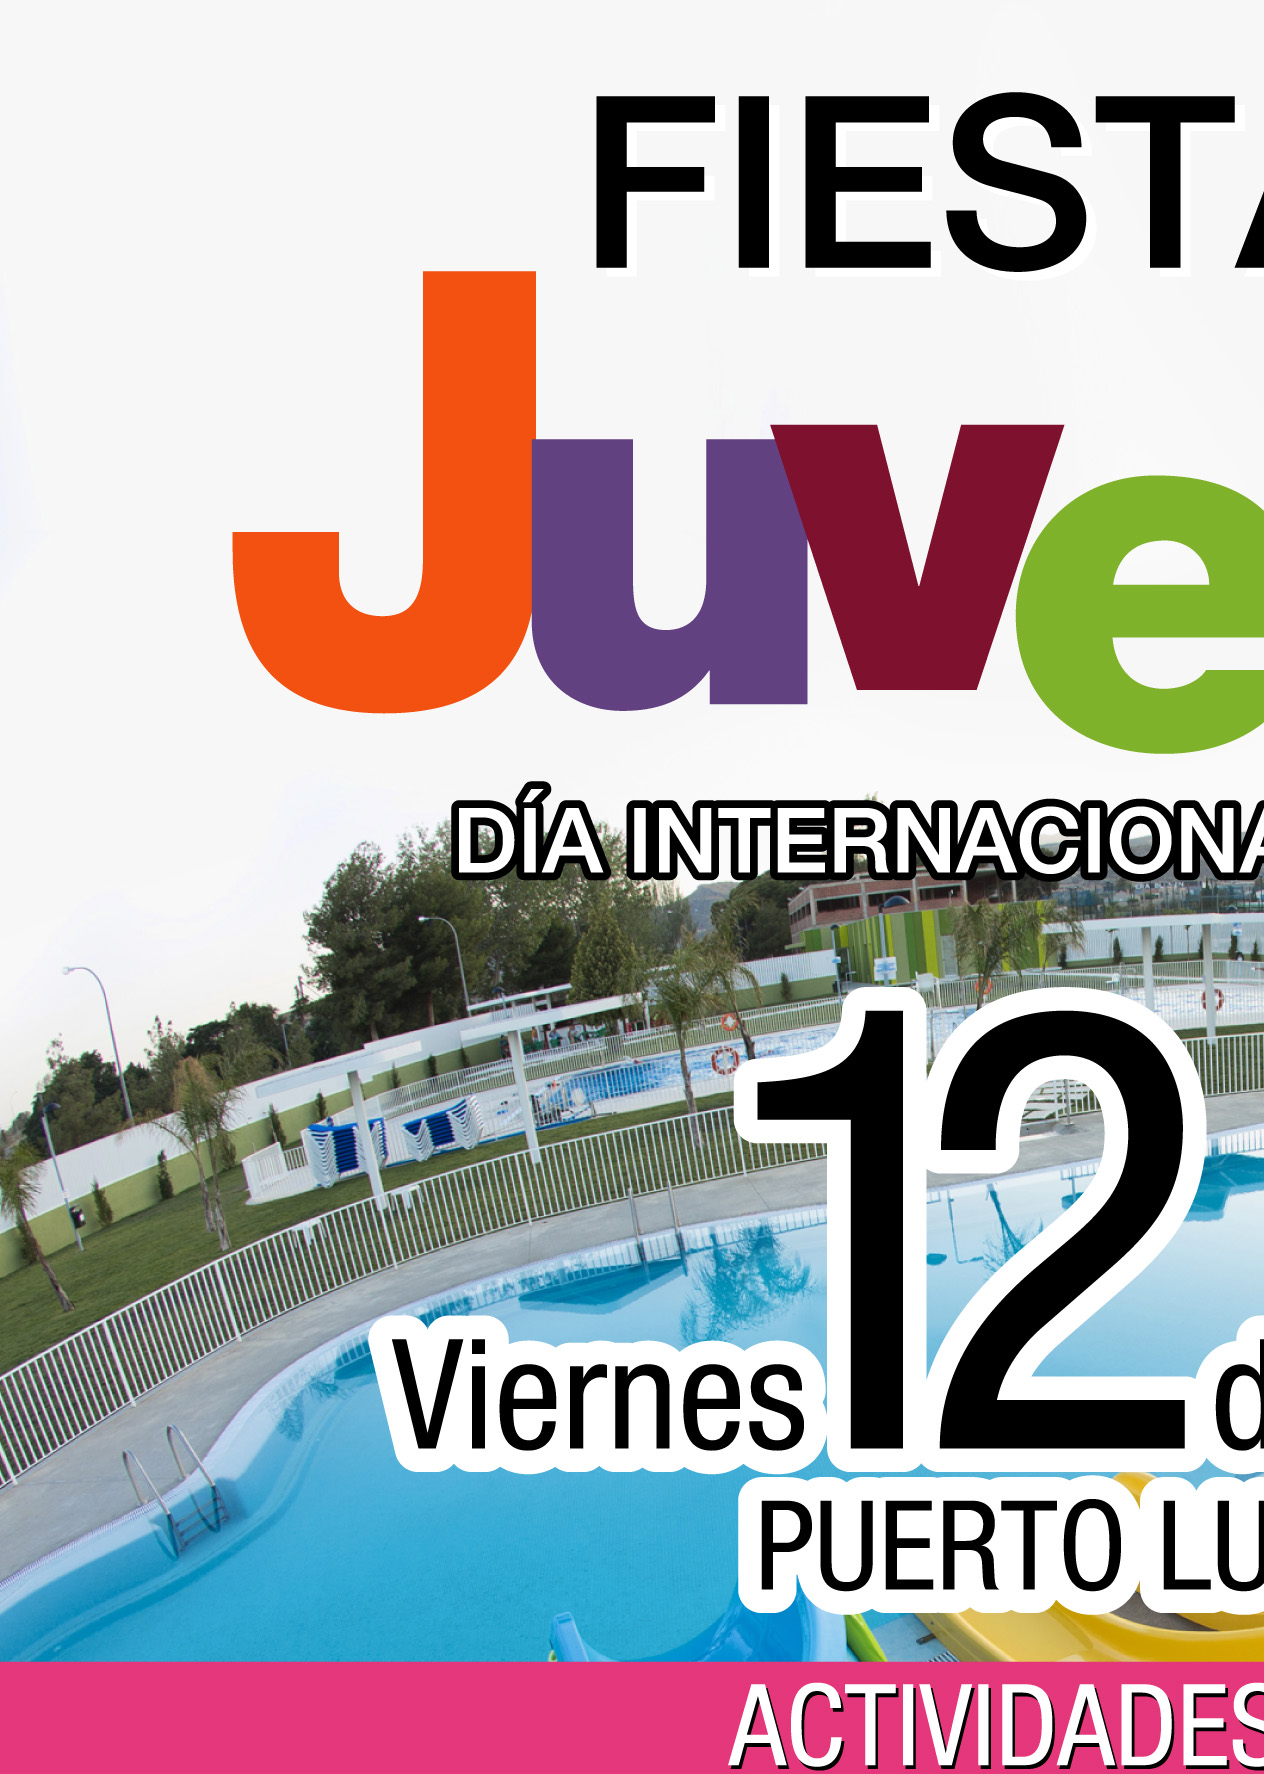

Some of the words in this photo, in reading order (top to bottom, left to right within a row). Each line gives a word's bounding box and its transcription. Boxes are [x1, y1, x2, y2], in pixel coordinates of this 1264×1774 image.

[459, 789, 603, 872] DÍA
[392, 1339, 804, 1450] Viernes
[758, 1011, 1184, 1448] 12
[762, 1499, 1121, 1591] PUERTO
